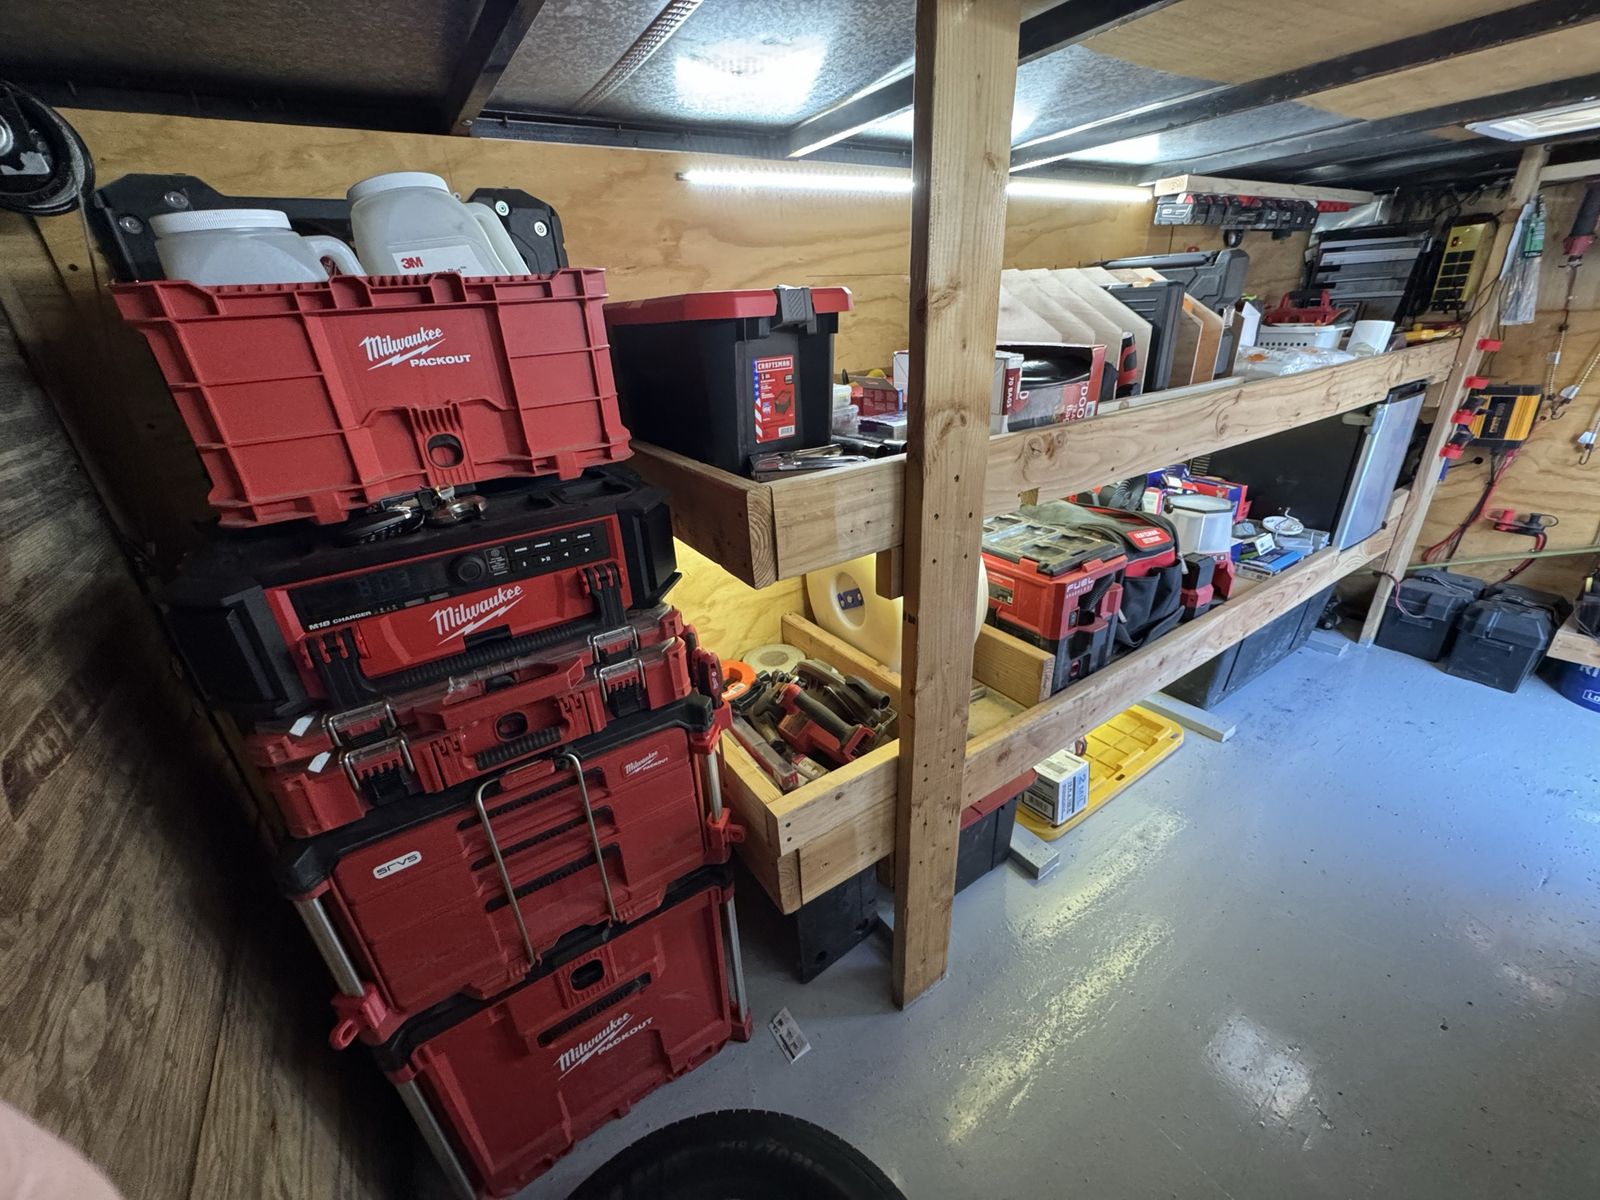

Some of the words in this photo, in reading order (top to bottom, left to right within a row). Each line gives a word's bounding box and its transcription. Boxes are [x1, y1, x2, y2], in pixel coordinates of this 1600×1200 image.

[401, 256, 424, 269] 3M
[359, 326, 444, 362] Milwaukee
[410, 354, 471, 368] PACKOUT
[308, 620, 331, 631] M18
[332, 611, 372, 624] CHARGER
[428, 585, 524, 636] Milwaukee
[624, 750, 658, 775] Milwaukee
[553, 1012, 631, 1072] Milwaukee
[597, 1017, 654, 1056] PACKOUT
